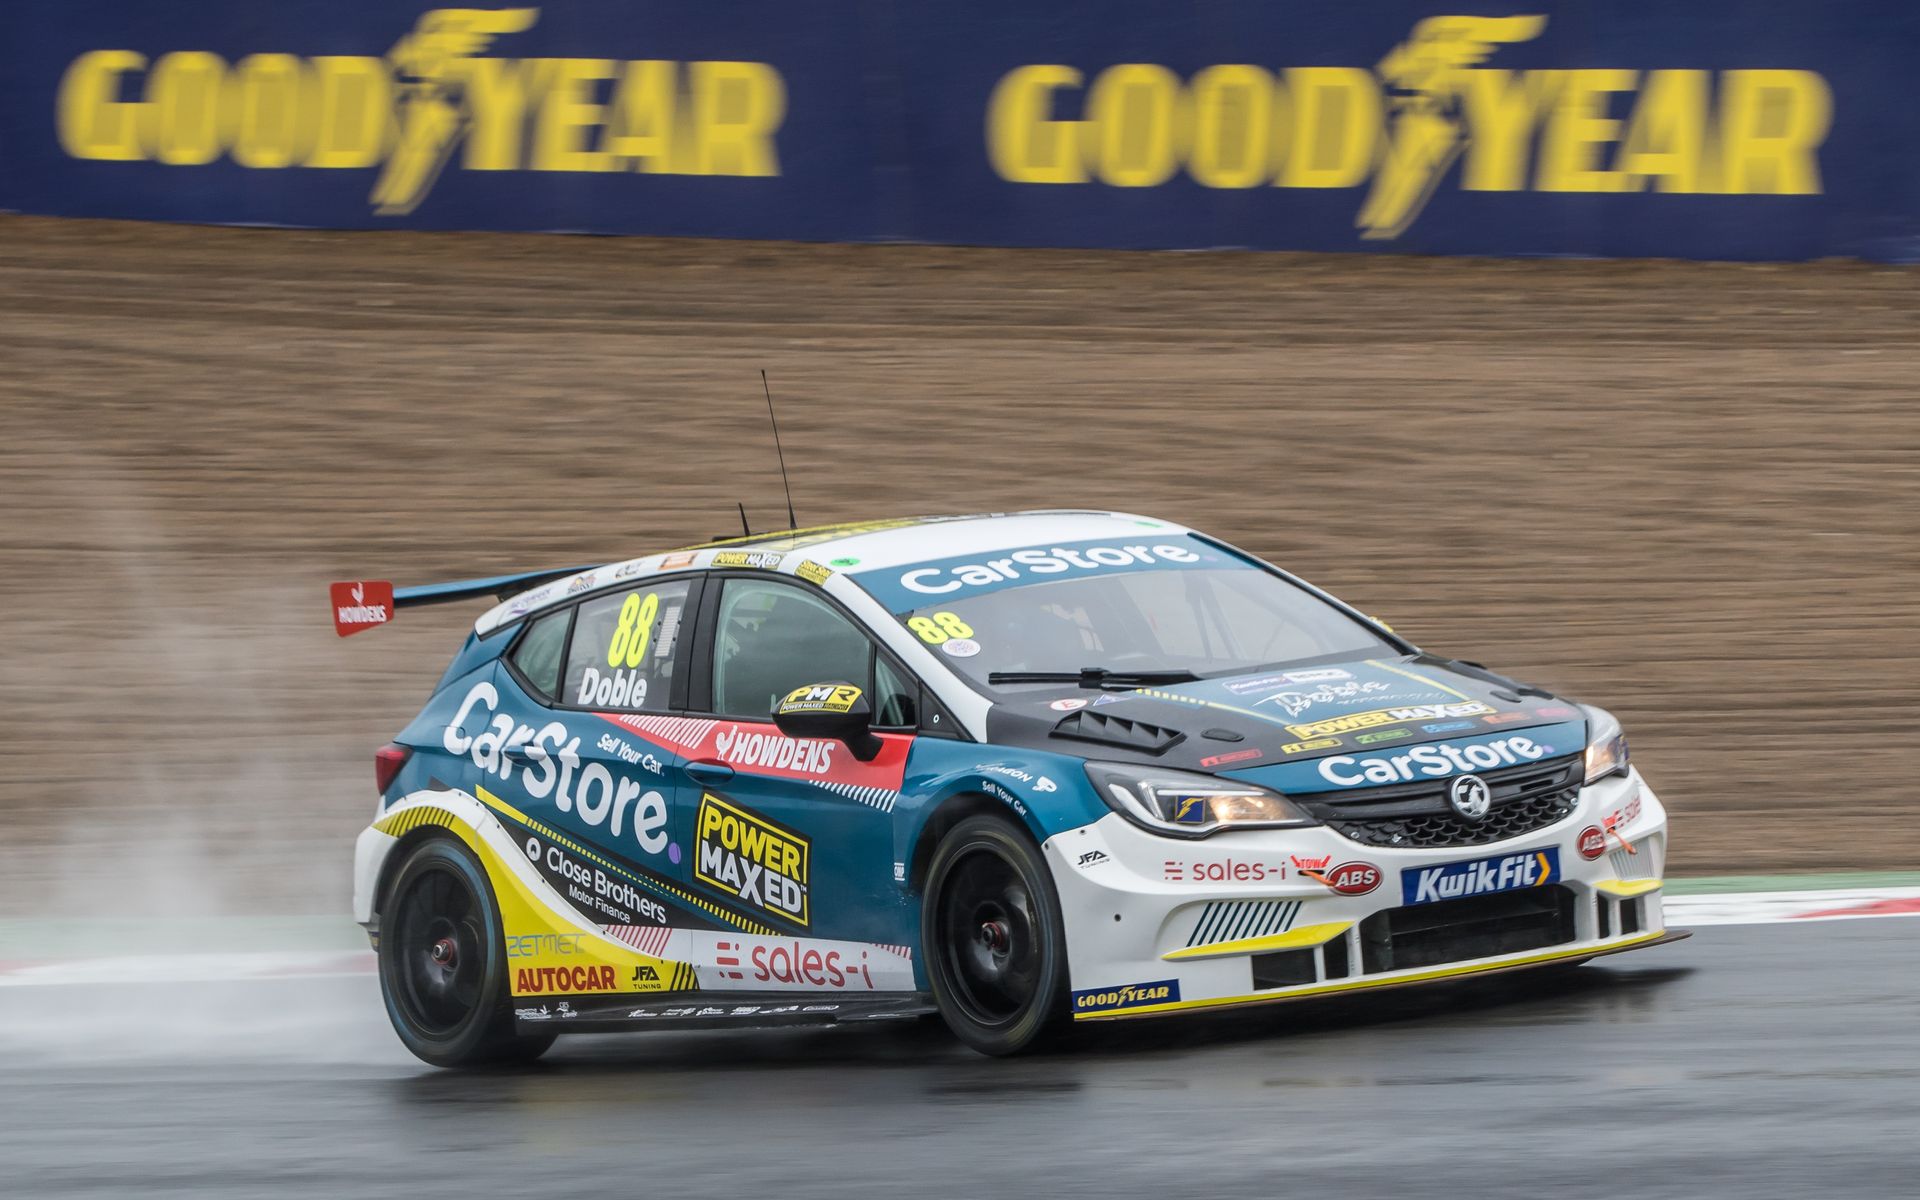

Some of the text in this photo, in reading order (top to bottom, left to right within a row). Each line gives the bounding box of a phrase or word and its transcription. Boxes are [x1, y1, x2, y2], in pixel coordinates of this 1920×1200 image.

[57, 49, 786, 178] GOODYEAR
[986, 63, 1834, 196] GOODYEAR
[606, 592, 660, 669] 88
[907, 611, 975, 645] 88
[577, 667, 648, 708] Doble
[786, 686, 858, 703] PMR
[1294, 712, 1395, 737] POWER
[1388, 700, 1488, 720] MAXED
[597, 733, 663, 775] Sell Your Car
[730, 733, 836, 774] HOWDENS
[982, 780, 997, 794] Sell
[996, 786, 1014, 805] Your
[702, 804, 801, 881] POWER
[1077, 850, 1108, 866] JFA
[700, 840, 803, 914] MAXED
[1192, 858, 1286, 881] sales-i
[1299, 858, 1322, 869] TOW
[1335, 869, 1376, 887] ABS
[546, 846, 667, 924] Close Brothers
[569, 884, 631, 924] Motor Finance
[517, 965, 617, 993] AUTOCAR
[632, 965, 660, 981] JFA
[751, 941, 874, 989] sales-i
[1077, 985, 1170, 1008] GOODYEAR
